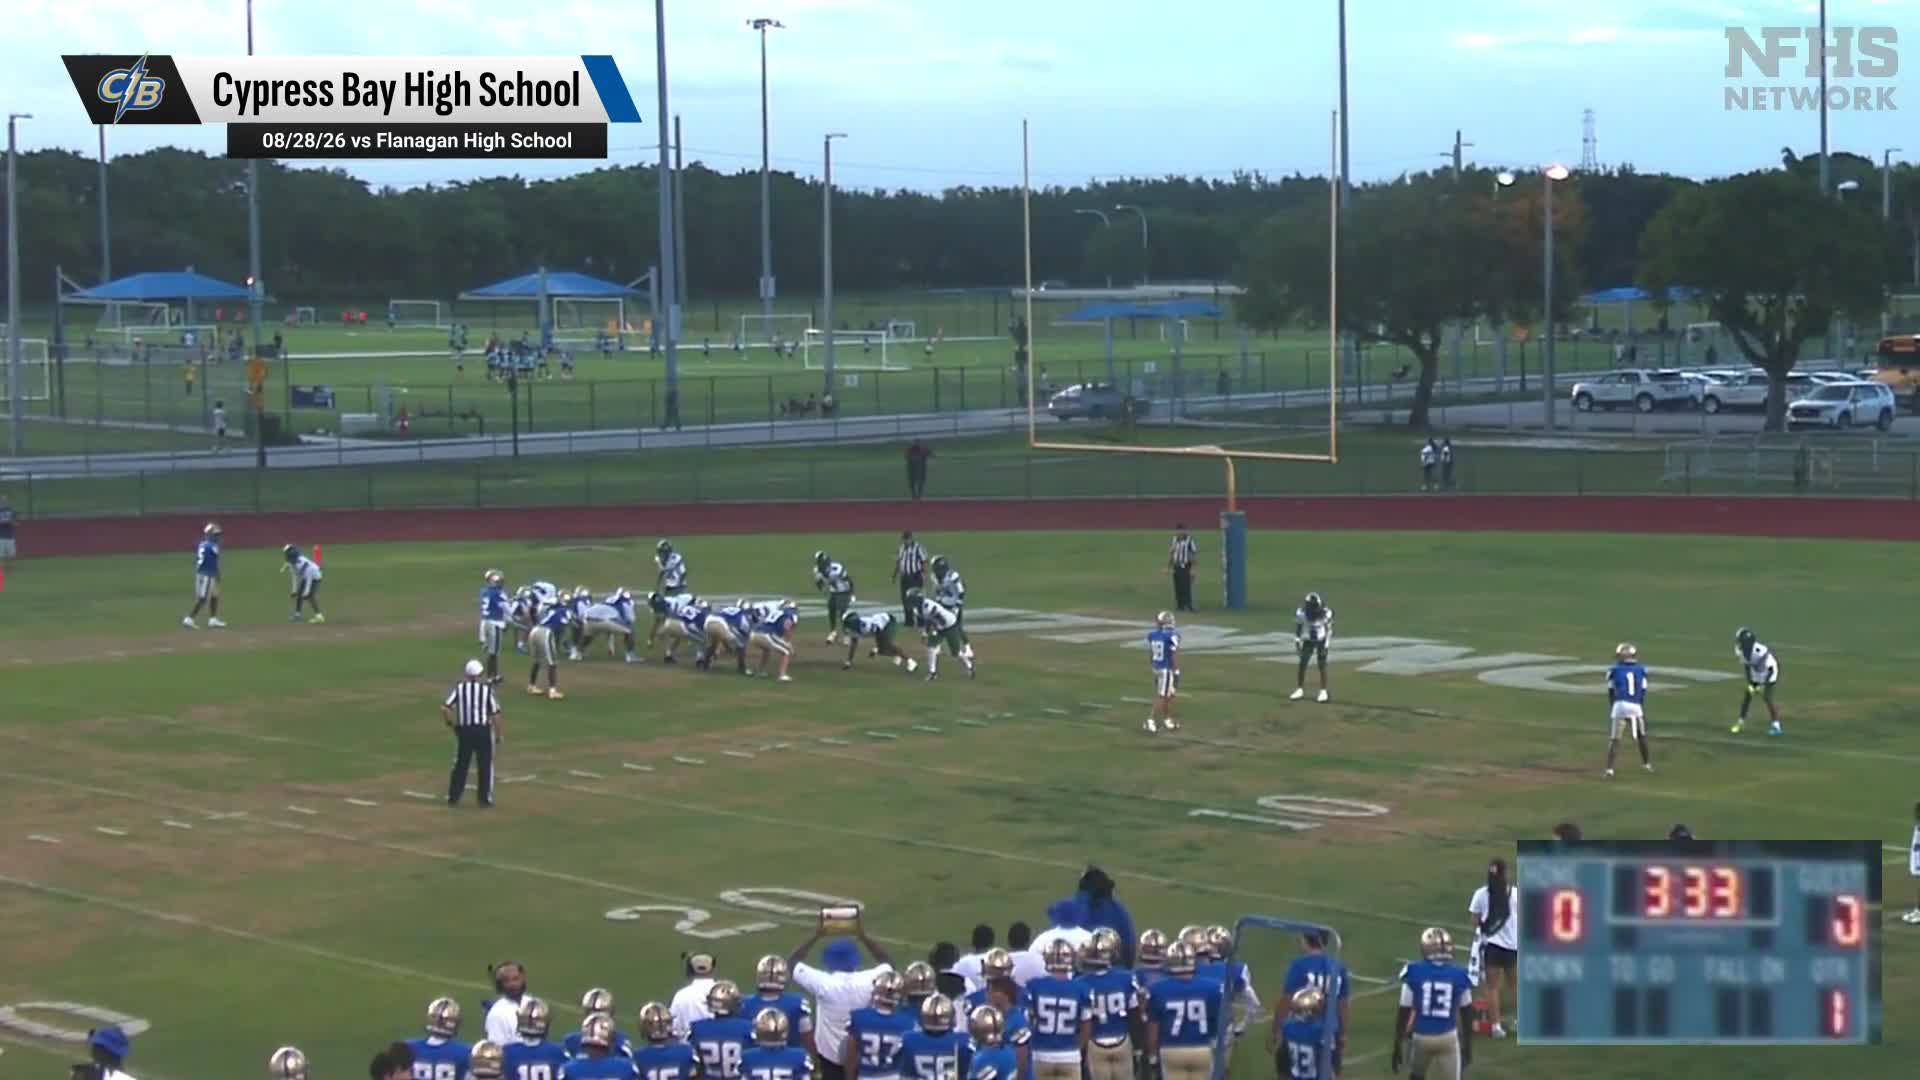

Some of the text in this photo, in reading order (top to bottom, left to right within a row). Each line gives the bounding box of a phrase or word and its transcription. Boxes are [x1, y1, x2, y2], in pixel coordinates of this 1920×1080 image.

[1626, 672, 1635, 696] 1
[1188, 795, 1389, 830] 10
[604, 887, 865, 939] 20
[1551, 889, 1582, 941] 0
[1038, 998, 1077, 1035] 52
[1166, 1000, 1208, 1036] 79
[1421, 982, 1451, 1018] 13
[1832, 991, 1843, 1034] 1
[701, 1041, 742, 1077] 28
[861, 1033, 902, 1066] 37
